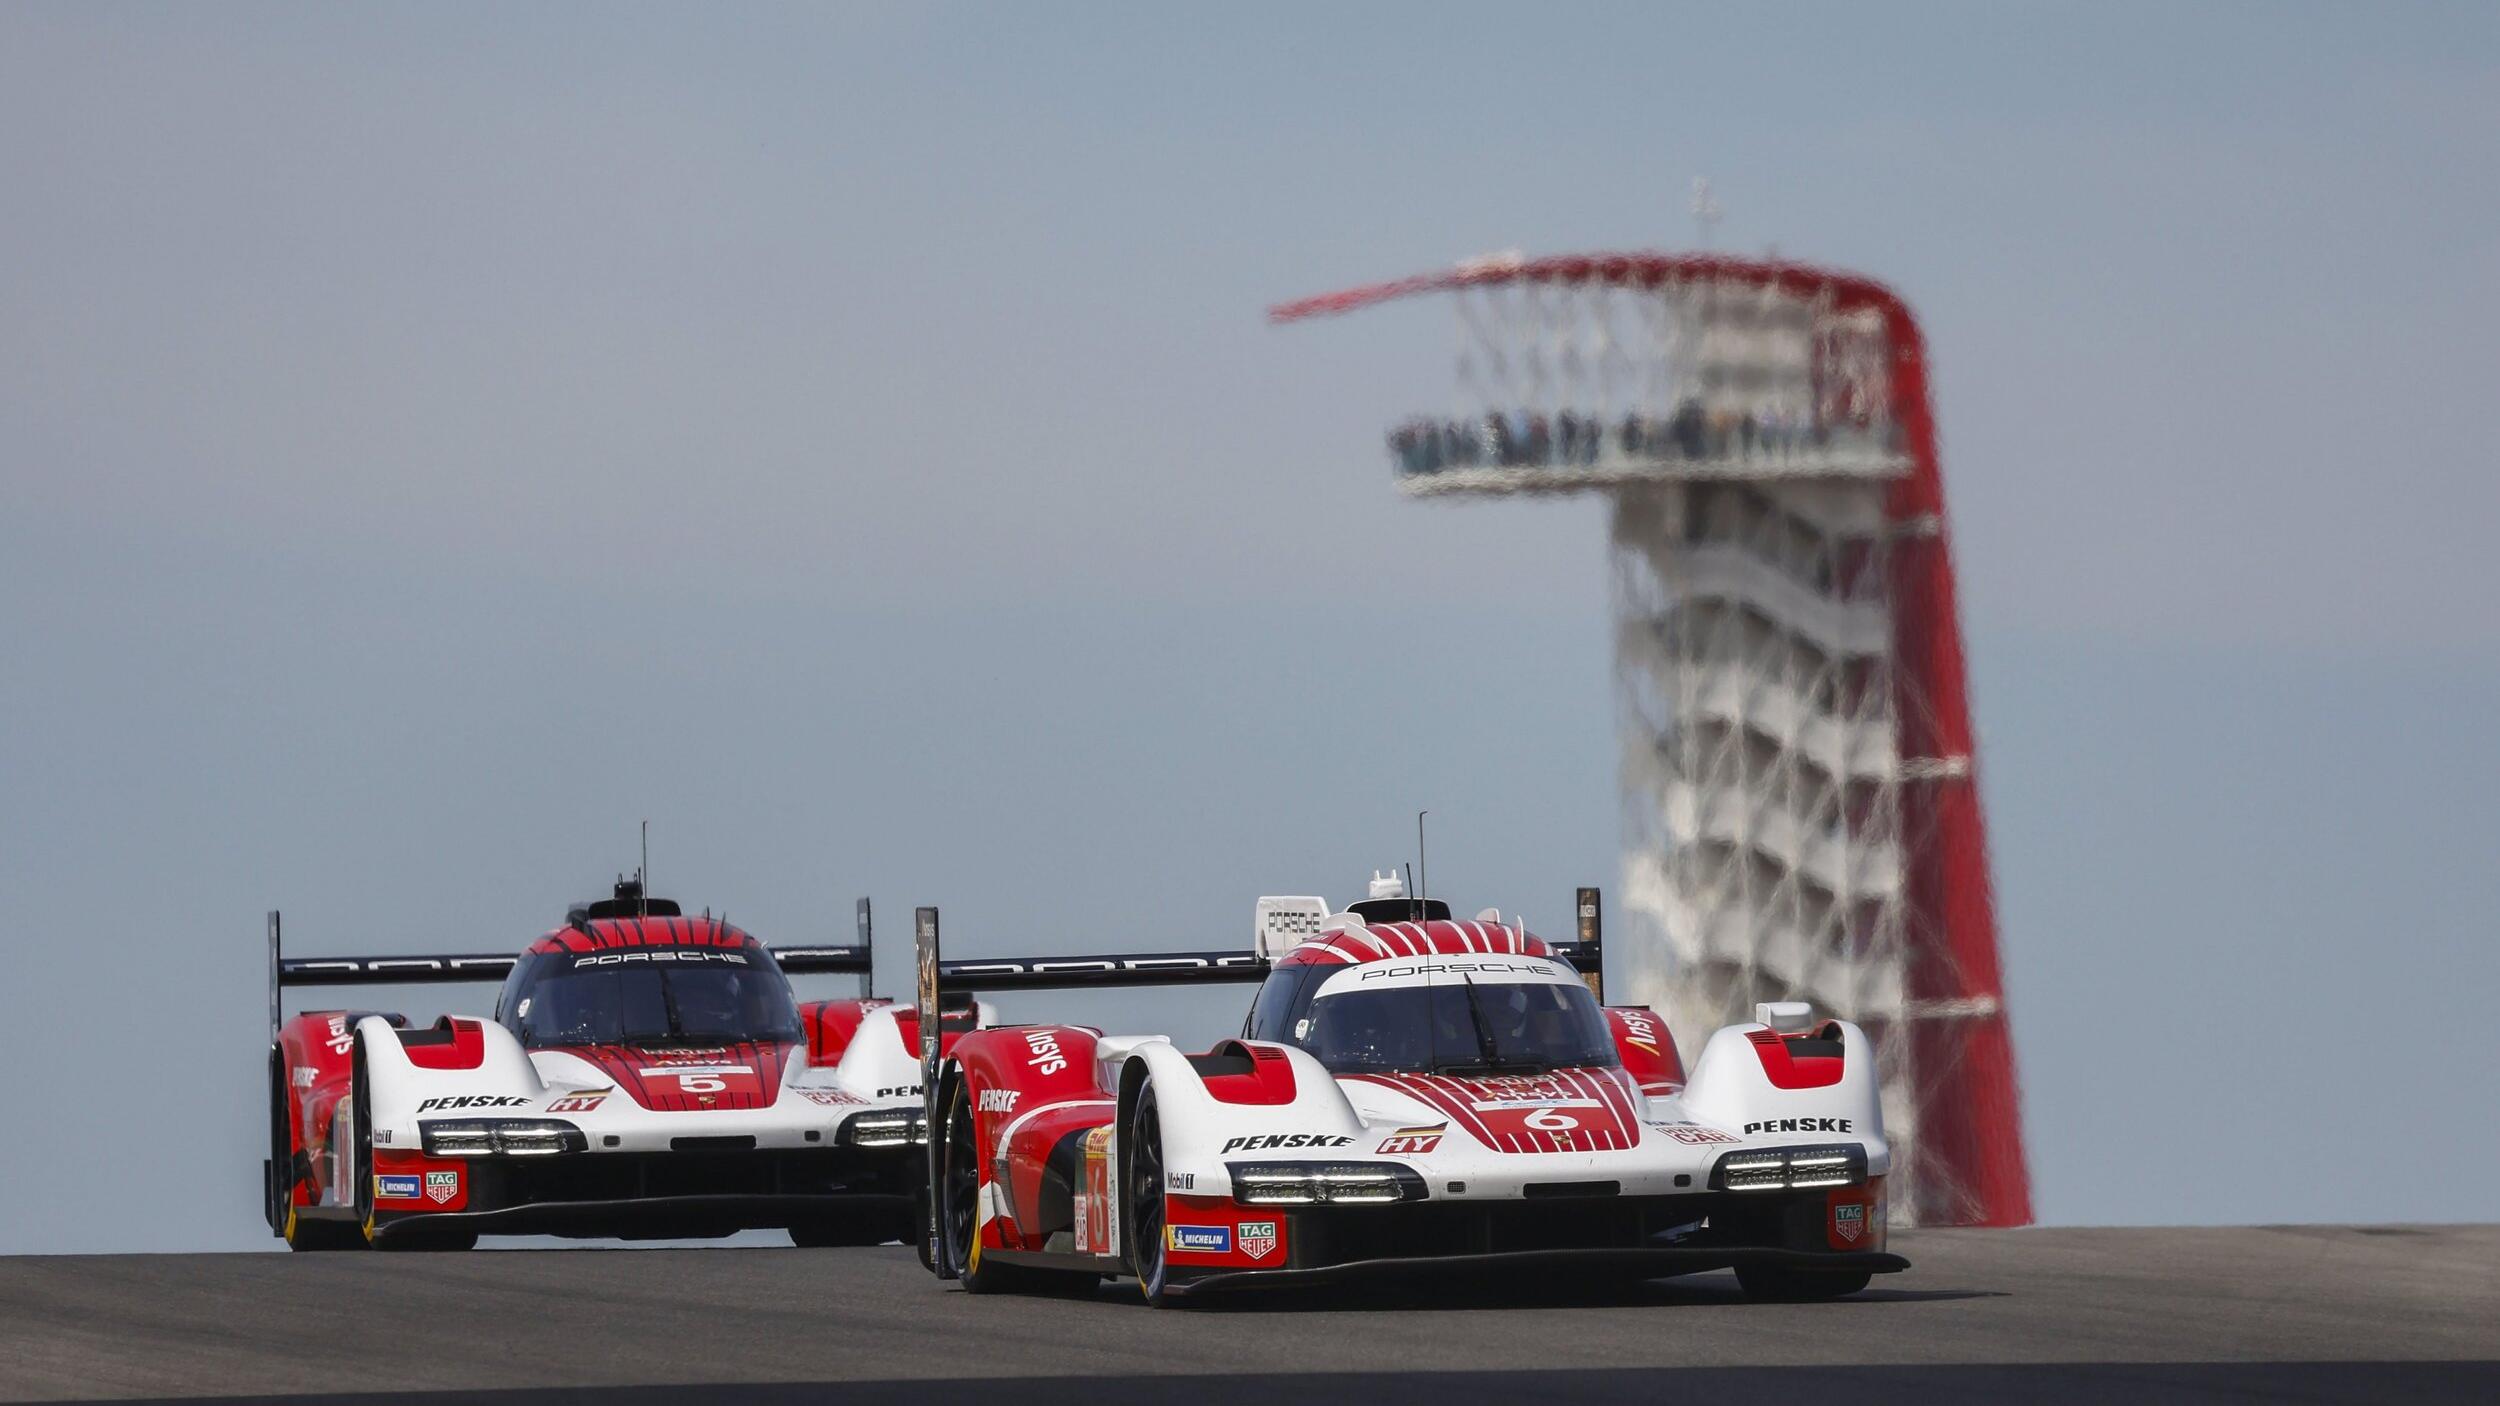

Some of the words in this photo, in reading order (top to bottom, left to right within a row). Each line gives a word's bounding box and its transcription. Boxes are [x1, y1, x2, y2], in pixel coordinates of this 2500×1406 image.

[1268, 911, 1320, 934] PORSCHE
[574, 951, 748, 968] PORSCHE
[1361, 963, 1556, 981] PORSCHE
[1022, 1029, 1067, 1075] Ansys
[679, 1074, 727, 1093] 5
[416, 1095, 534, 1113] PENSKE
[978, 1088, 1021, 1113] PENSKE
[1523, 1108, 1579, 1130] 6
[1744, 1117, 1852, 1135] PENSKE
[1220, 1134, 1356, 1154] PENSKE
[1378, 1134, 1442, 1153] HY
[428, 1174, 455, 1185] TAG
[1167, 1172, 1185, 1189] Mobil
[1185, 1173, 1195, 1190] 1
[428, 1186, 456, 1201] HEUER
[1838, 1207, 1861, 1219] TAG
[1241, 1225, 1272, 1237] TAG
[1838, 1221, 1862, 1238] HEUER
[1184, 1234, 1224, 1245] MICHELIN
[1240, 1238, 1273, 1257] HEUER
